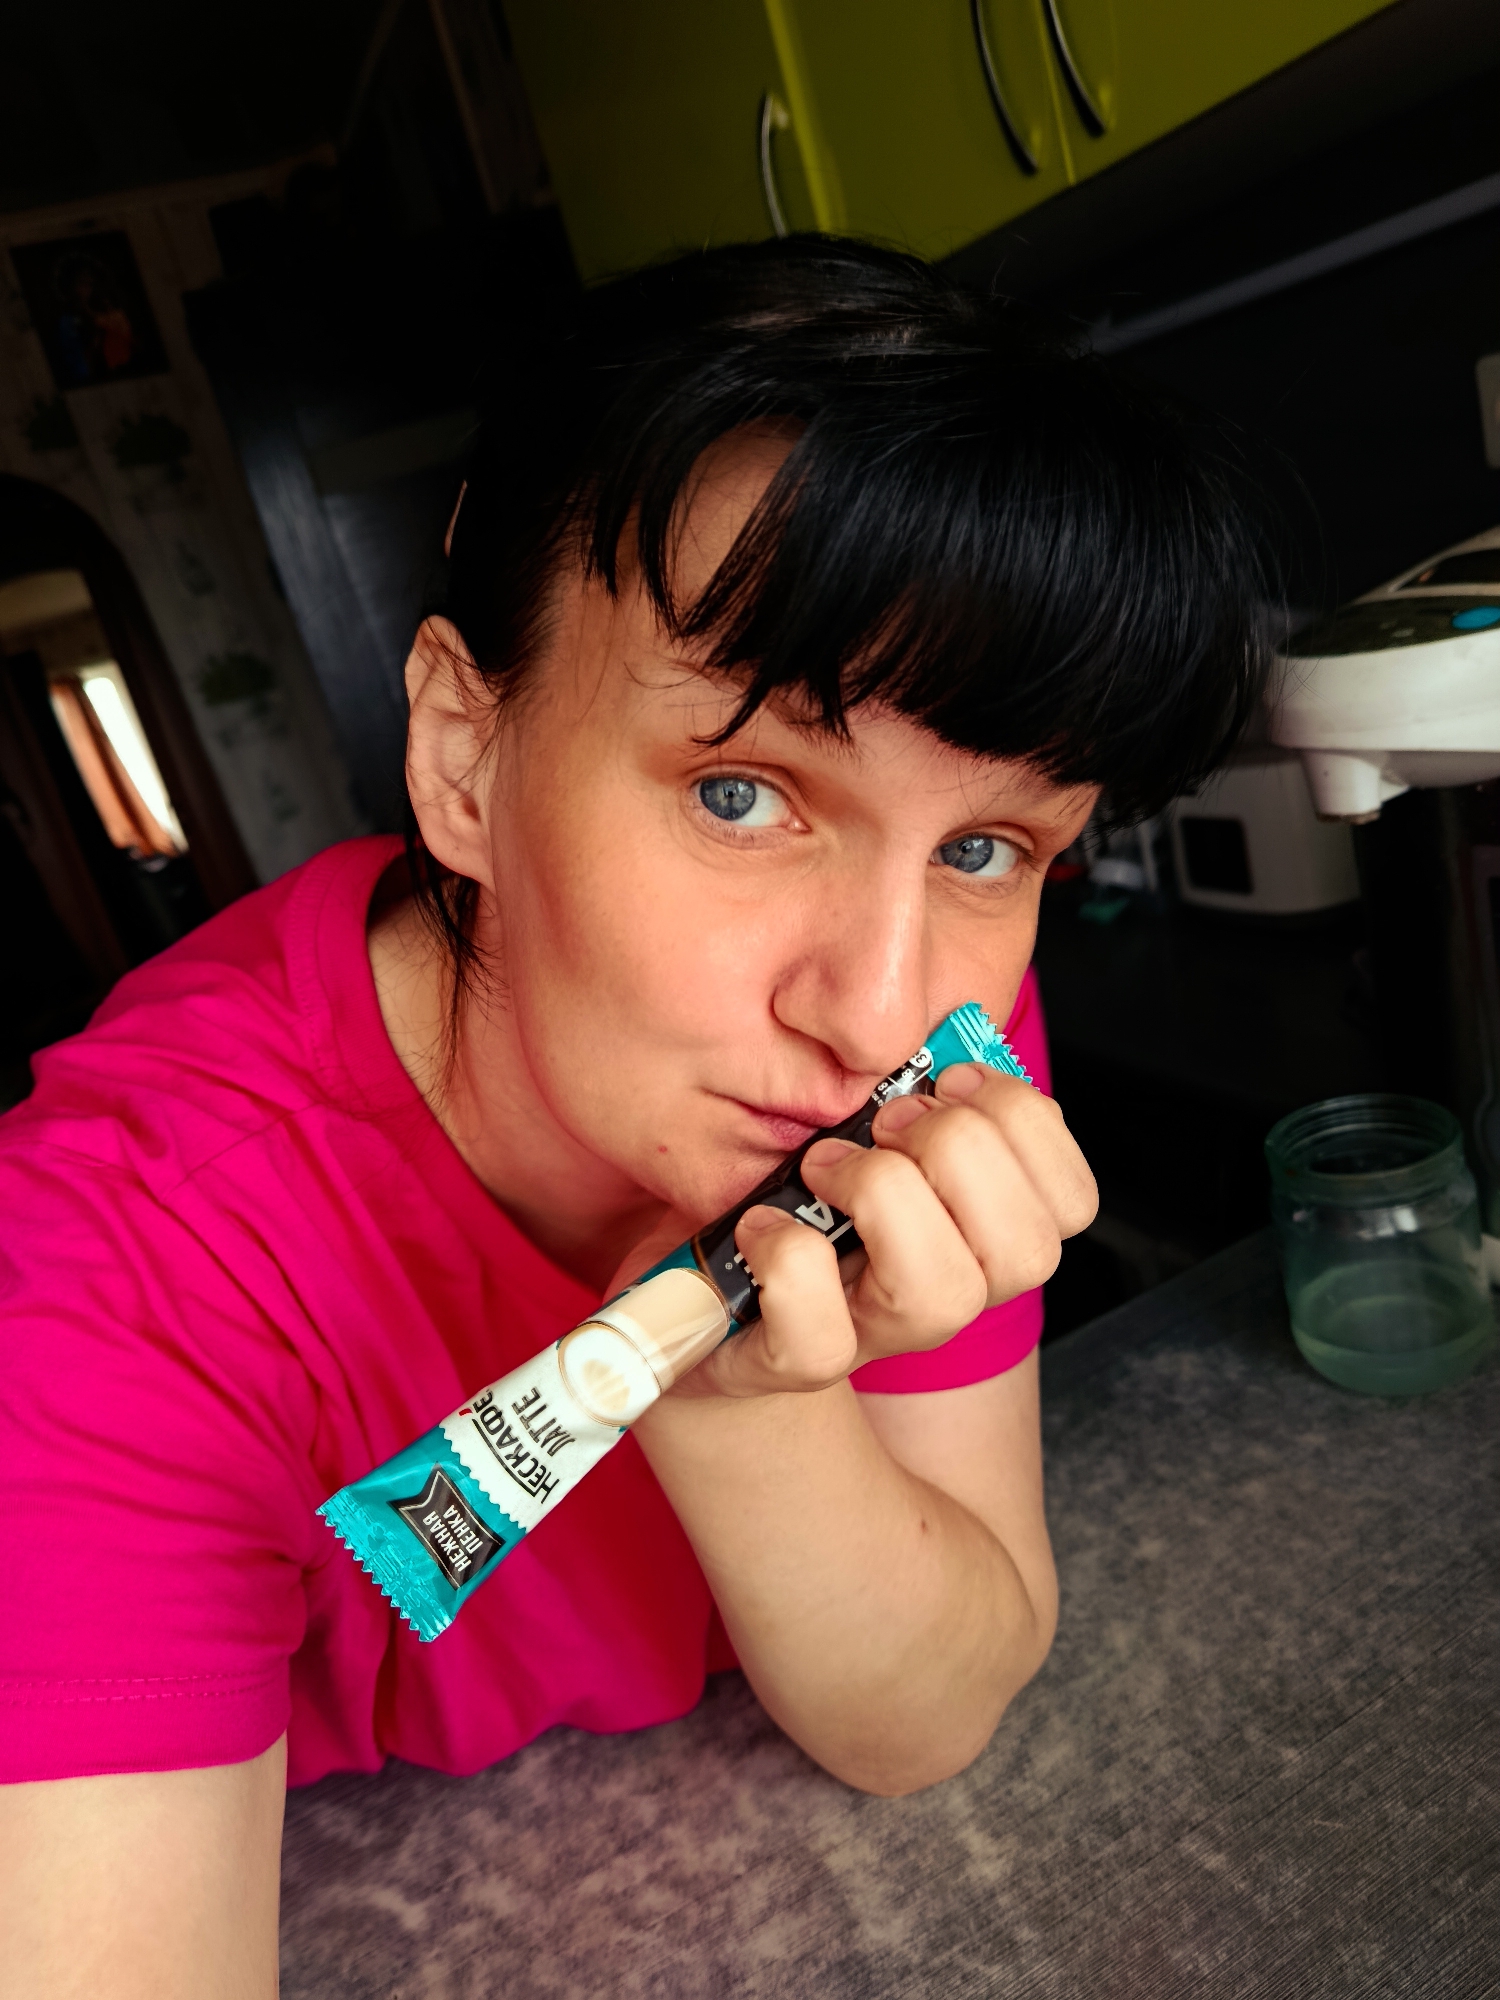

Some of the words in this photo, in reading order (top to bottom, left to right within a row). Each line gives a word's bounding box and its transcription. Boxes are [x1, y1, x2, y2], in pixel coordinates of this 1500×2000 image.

[512, 1387, 576, 1457] ЛАТТЕ
[423, 1512, 472, 1571] НЕЖНАЯ
[443, 1505, 482, 1553] ПЕНКА
